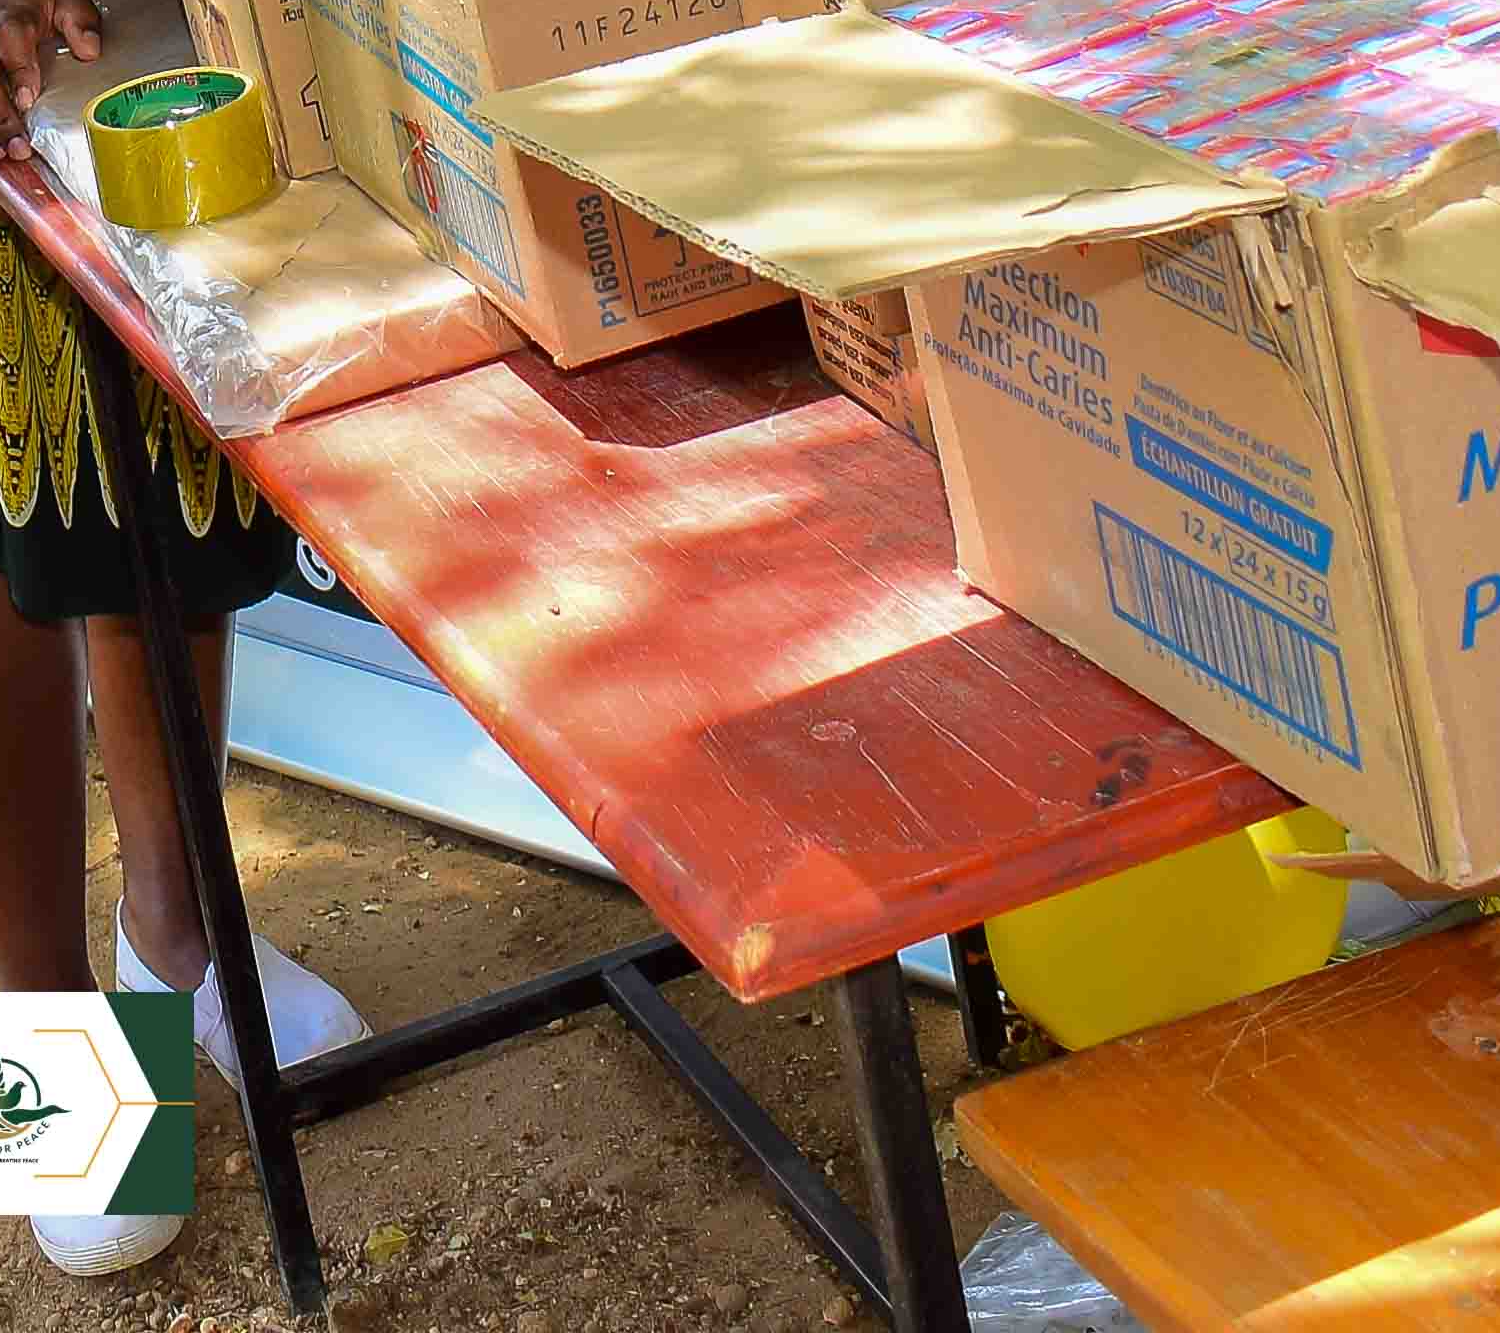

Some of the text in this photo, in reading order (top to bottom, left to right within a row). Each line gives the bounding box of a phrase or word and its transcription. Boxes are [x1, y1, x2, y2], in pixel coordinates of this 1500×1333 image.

[576, 194, 627, 329] P1650033
[644, 269, 698, 293] PROTECT
[984, 262, 1099, 334] tection
[958, 309, 1113, 425] Anti-Caries
[965, 275, 1107, 382] Maximum
[923, 332, 979, 377] Proteção
[982, 363, 1034, 408] Máxima
[1037, 396, 1055, 421] da
[1058, 408, 1121, 459] Cavidade
[1140, 430, 1320, 556] ÉCHANTILLON GRATUIT
[1179, 509, 1329, 622] 12 x 24 x 15 g
